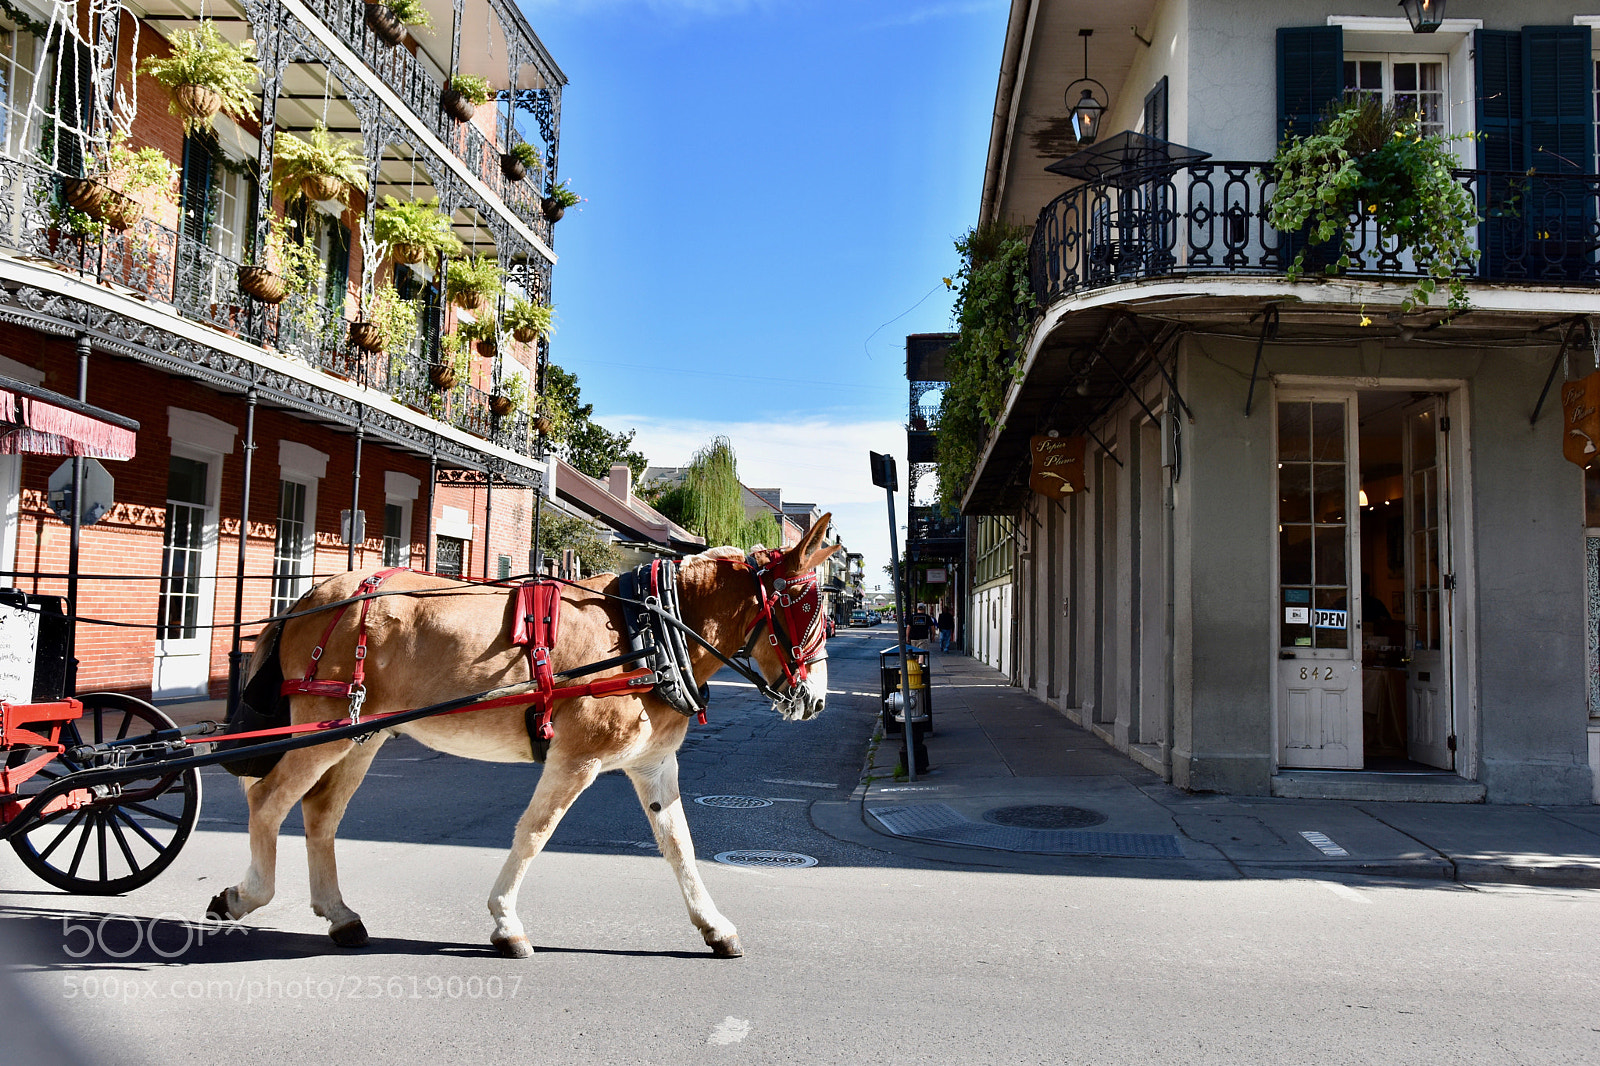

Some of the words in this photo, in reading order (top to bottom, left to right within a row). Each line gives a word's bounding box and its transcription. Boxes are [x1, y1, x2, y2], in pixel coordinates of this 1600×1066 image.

[1036, 440, 1066, 453] Papier
[1044, 454, 1075, 467] Plume
[1312, 611, 1345, 627] OPEN
[1300, 666, 1333, 681] 842
